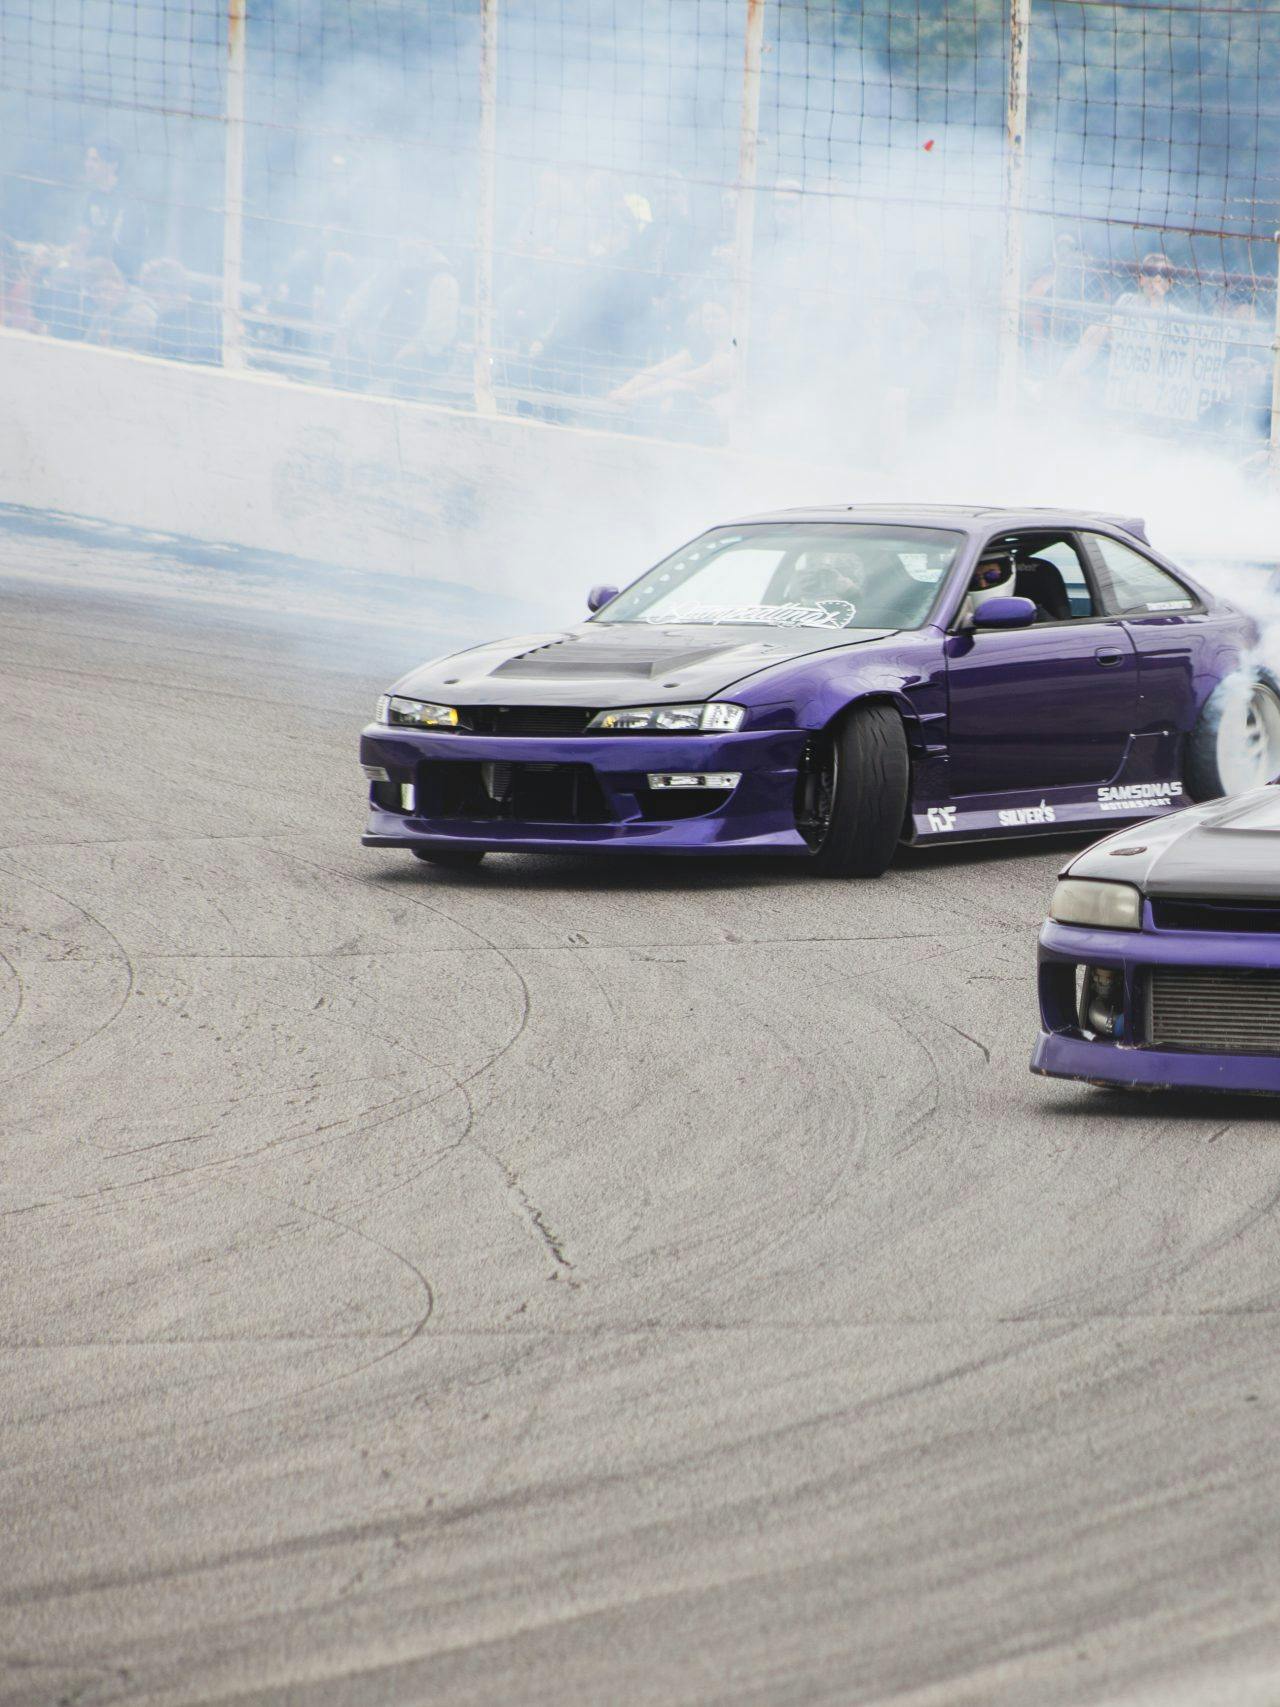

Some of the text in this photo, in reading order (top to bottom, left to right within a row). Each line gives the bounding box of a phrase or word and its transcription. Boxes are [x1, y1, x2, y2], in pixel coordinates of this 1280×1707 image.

[1114, 341, 1230, 385] DOES NOT OPEN
[1097, 781, 1183, 802] SAMSONAS
[1099, 797, 1172, 812] MOTORSPORT
